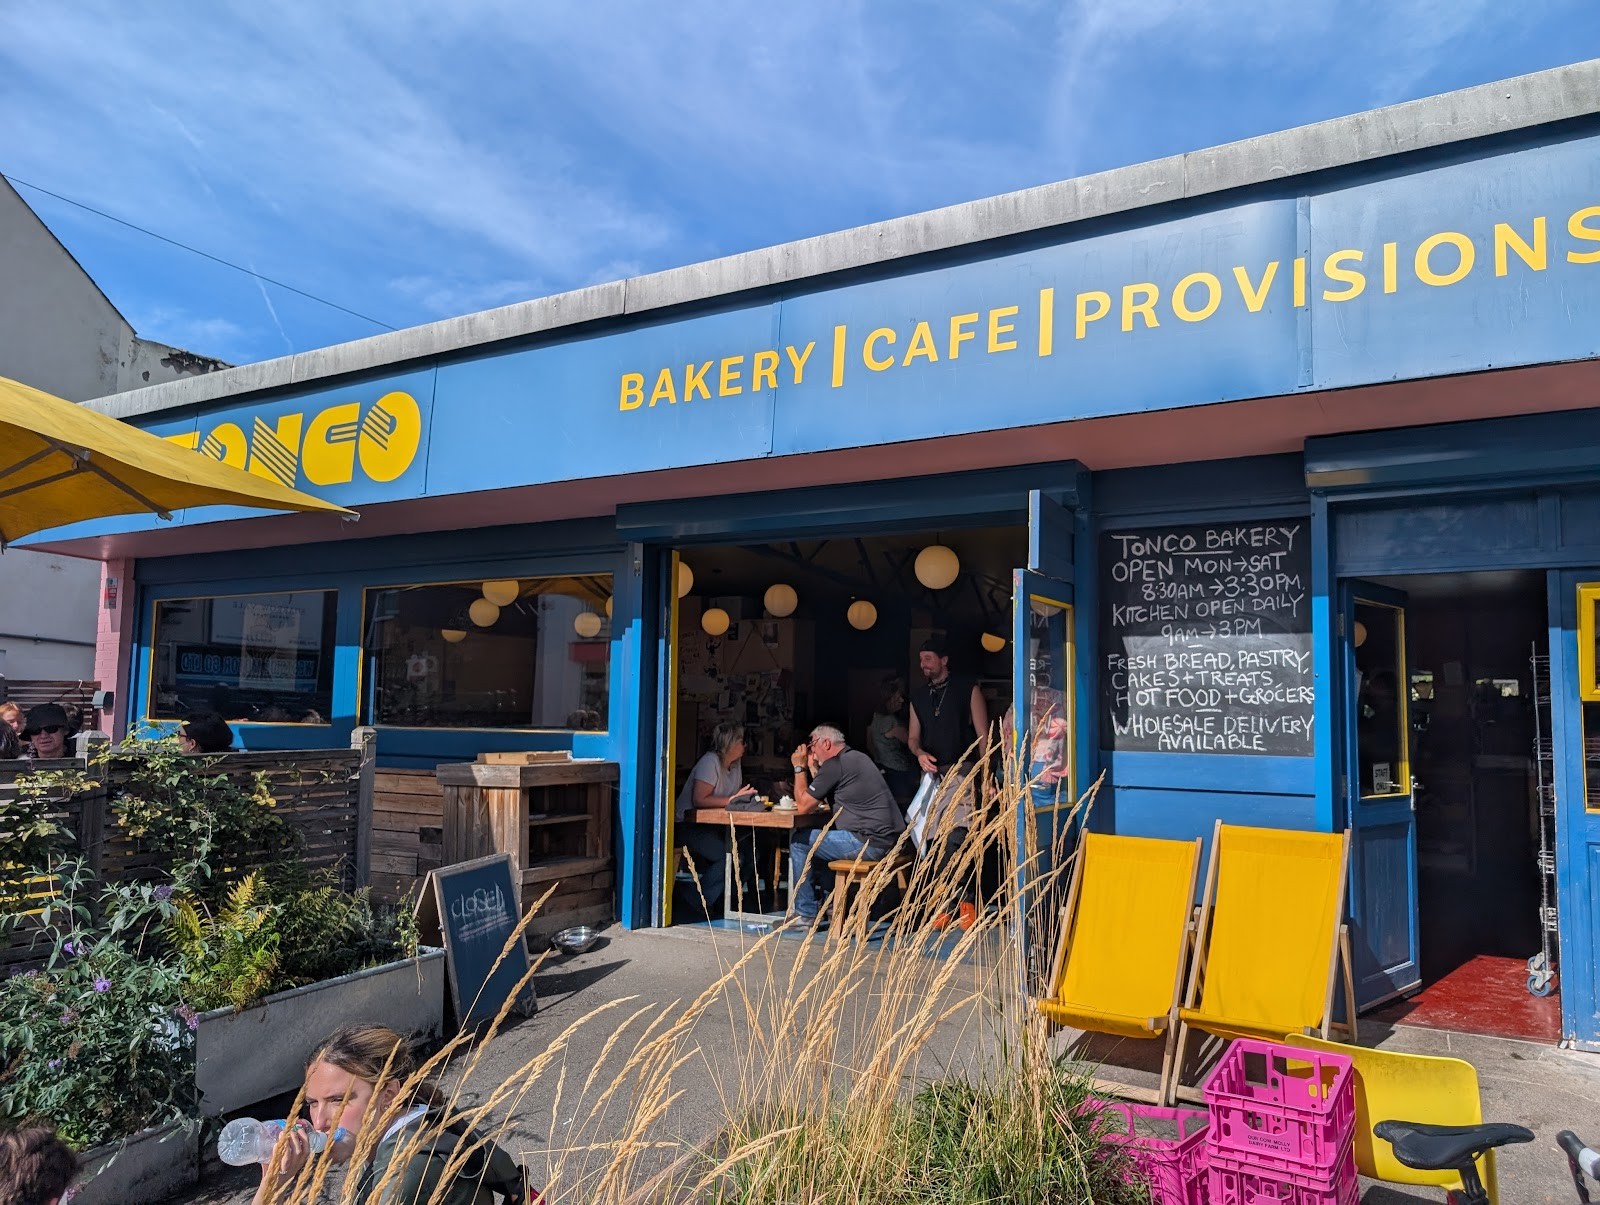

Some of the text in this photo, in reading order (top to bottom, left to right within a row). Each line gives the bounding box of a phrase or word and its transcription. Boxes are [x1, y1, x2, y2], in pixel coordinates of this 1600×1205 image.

[619, 206, 1600, 411] BAKERY CAFE PROVISIONS
[161, 391, 421, 488] ONCO
[1205, 525, 1300, 551] BAKERY
[1112, 557, 1174, 582] OPEN
[1142, 582, 1205, 601] 8:30AM
[1112, 593, 1305, 626] KITCHEN OPEN DAILY
[1108, 653, 1157, 670] FRESH
[1115, 688, 1162, 707] HOT
[1166, 688, 1221, 708] FOOD
[1112, 714, 1315, 741] WHOLESALE DELIVERY
[1158, 732, 1267, 752] AVAILABLE
